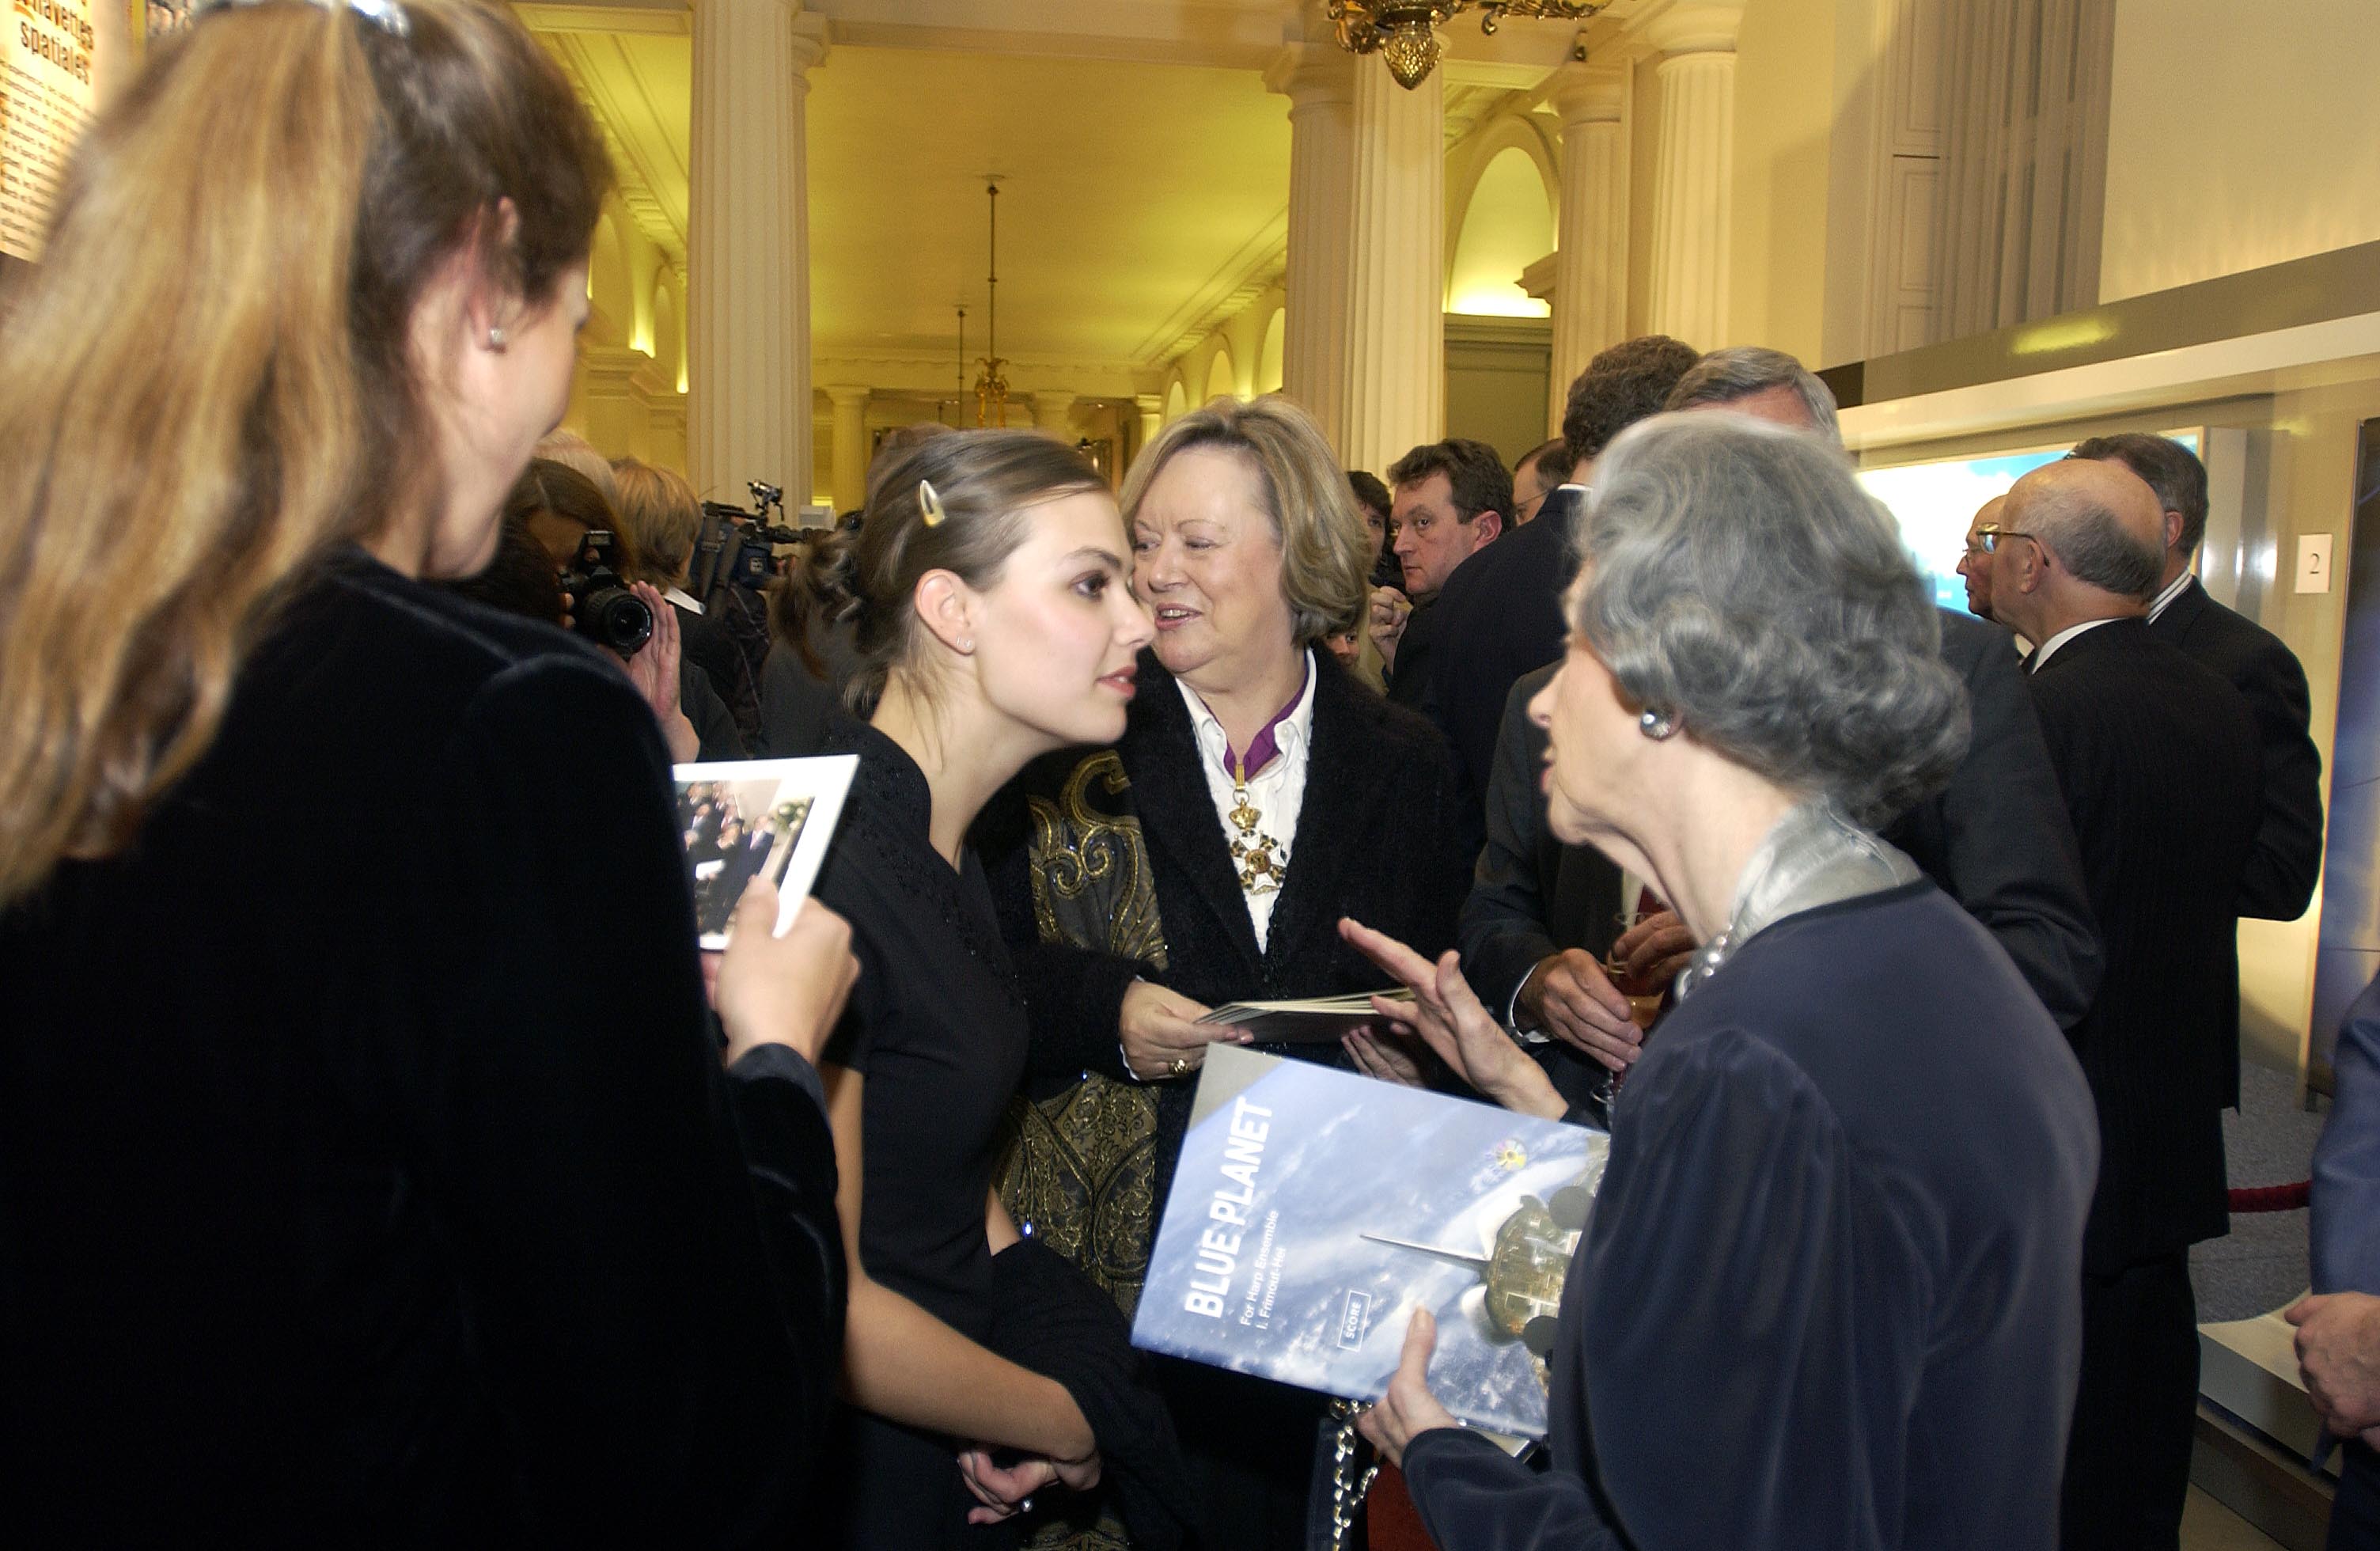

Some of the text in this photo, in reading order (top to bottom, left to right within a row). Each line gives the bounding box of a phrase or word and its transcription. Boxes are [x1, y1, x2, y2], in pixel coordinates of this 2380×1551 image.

[20, 21, 89, 85] spatiales
[2309, 552, 2321, 575] 2
[1184, 1095, 1272, 1318] BLUE PLANET
[1240, 1210, 1279, 1326] For Harp Ensemble
[1345, 1302, 1362, 1339] SCORE
